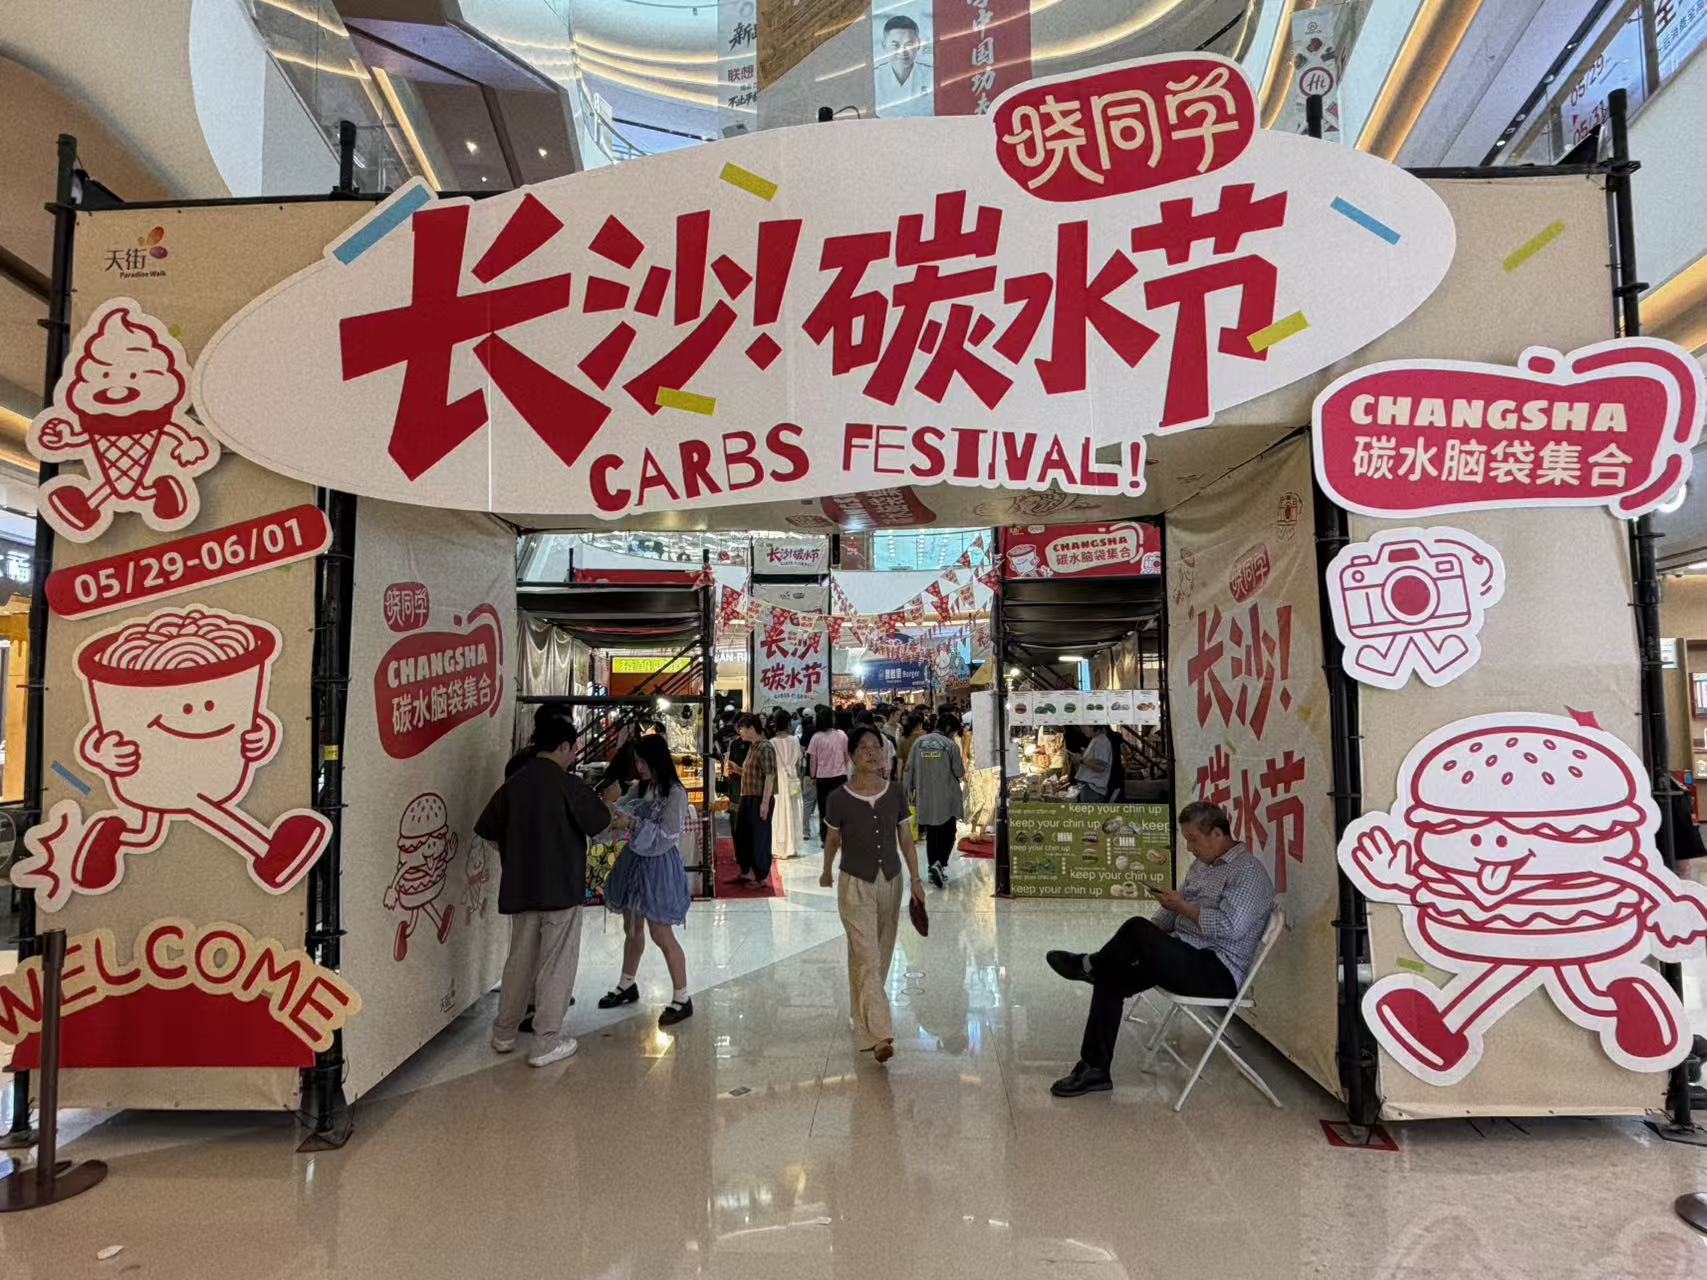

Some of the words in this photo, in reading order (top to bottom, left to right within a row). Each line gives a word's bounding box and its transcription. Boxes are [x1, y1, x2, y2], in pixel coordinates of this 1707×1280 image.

[1002, 67, 1240, 190] 晓同学
[104, 247, 148, 272] 天街
[1350, 393, 1628, 432] CHANGSHA
[590, 422, 810, 513] CARBS
[842, 422, 1148, 497] FESTIVAL!
[1353, 435, 1633, 488] 碳水脑袋集合
[74, 518, 304, 603] 05/29-06/01
[1052, 536, 1129, 552] CHANGSHA
[385, 586, 429, 627] 晓同学
[387, 642, 489, 689] CHANGSHA
[760, 661, 823, 694] 碳水节
[391, 672, 493, 736] 碳水脑袋集合
[1010, 819, 1035, 831] keep
[1038, 821, 1060, 831] your
[1063, 819, 1085, 829] chin
[1087, 821, 1101, 831] up
[1068, 803, 1095, 815] keep
[1097, 805, 1121, 815] your
[1122, 804, 1146, 814] chin
[1148, 807, 1162, 816] up
[1011, 884, 1036, 896] keep
[1038, 886, 1062, 897] your
[1064, 885, 1087, 895] chin
[1089, 888, 1104, 898] up
[1070, 869, 1096, 881] keep
[1098, 871, 1122, 882] your
[1124, 870, 1147, 881] chin
[1150, 873, 1165, 884] up
